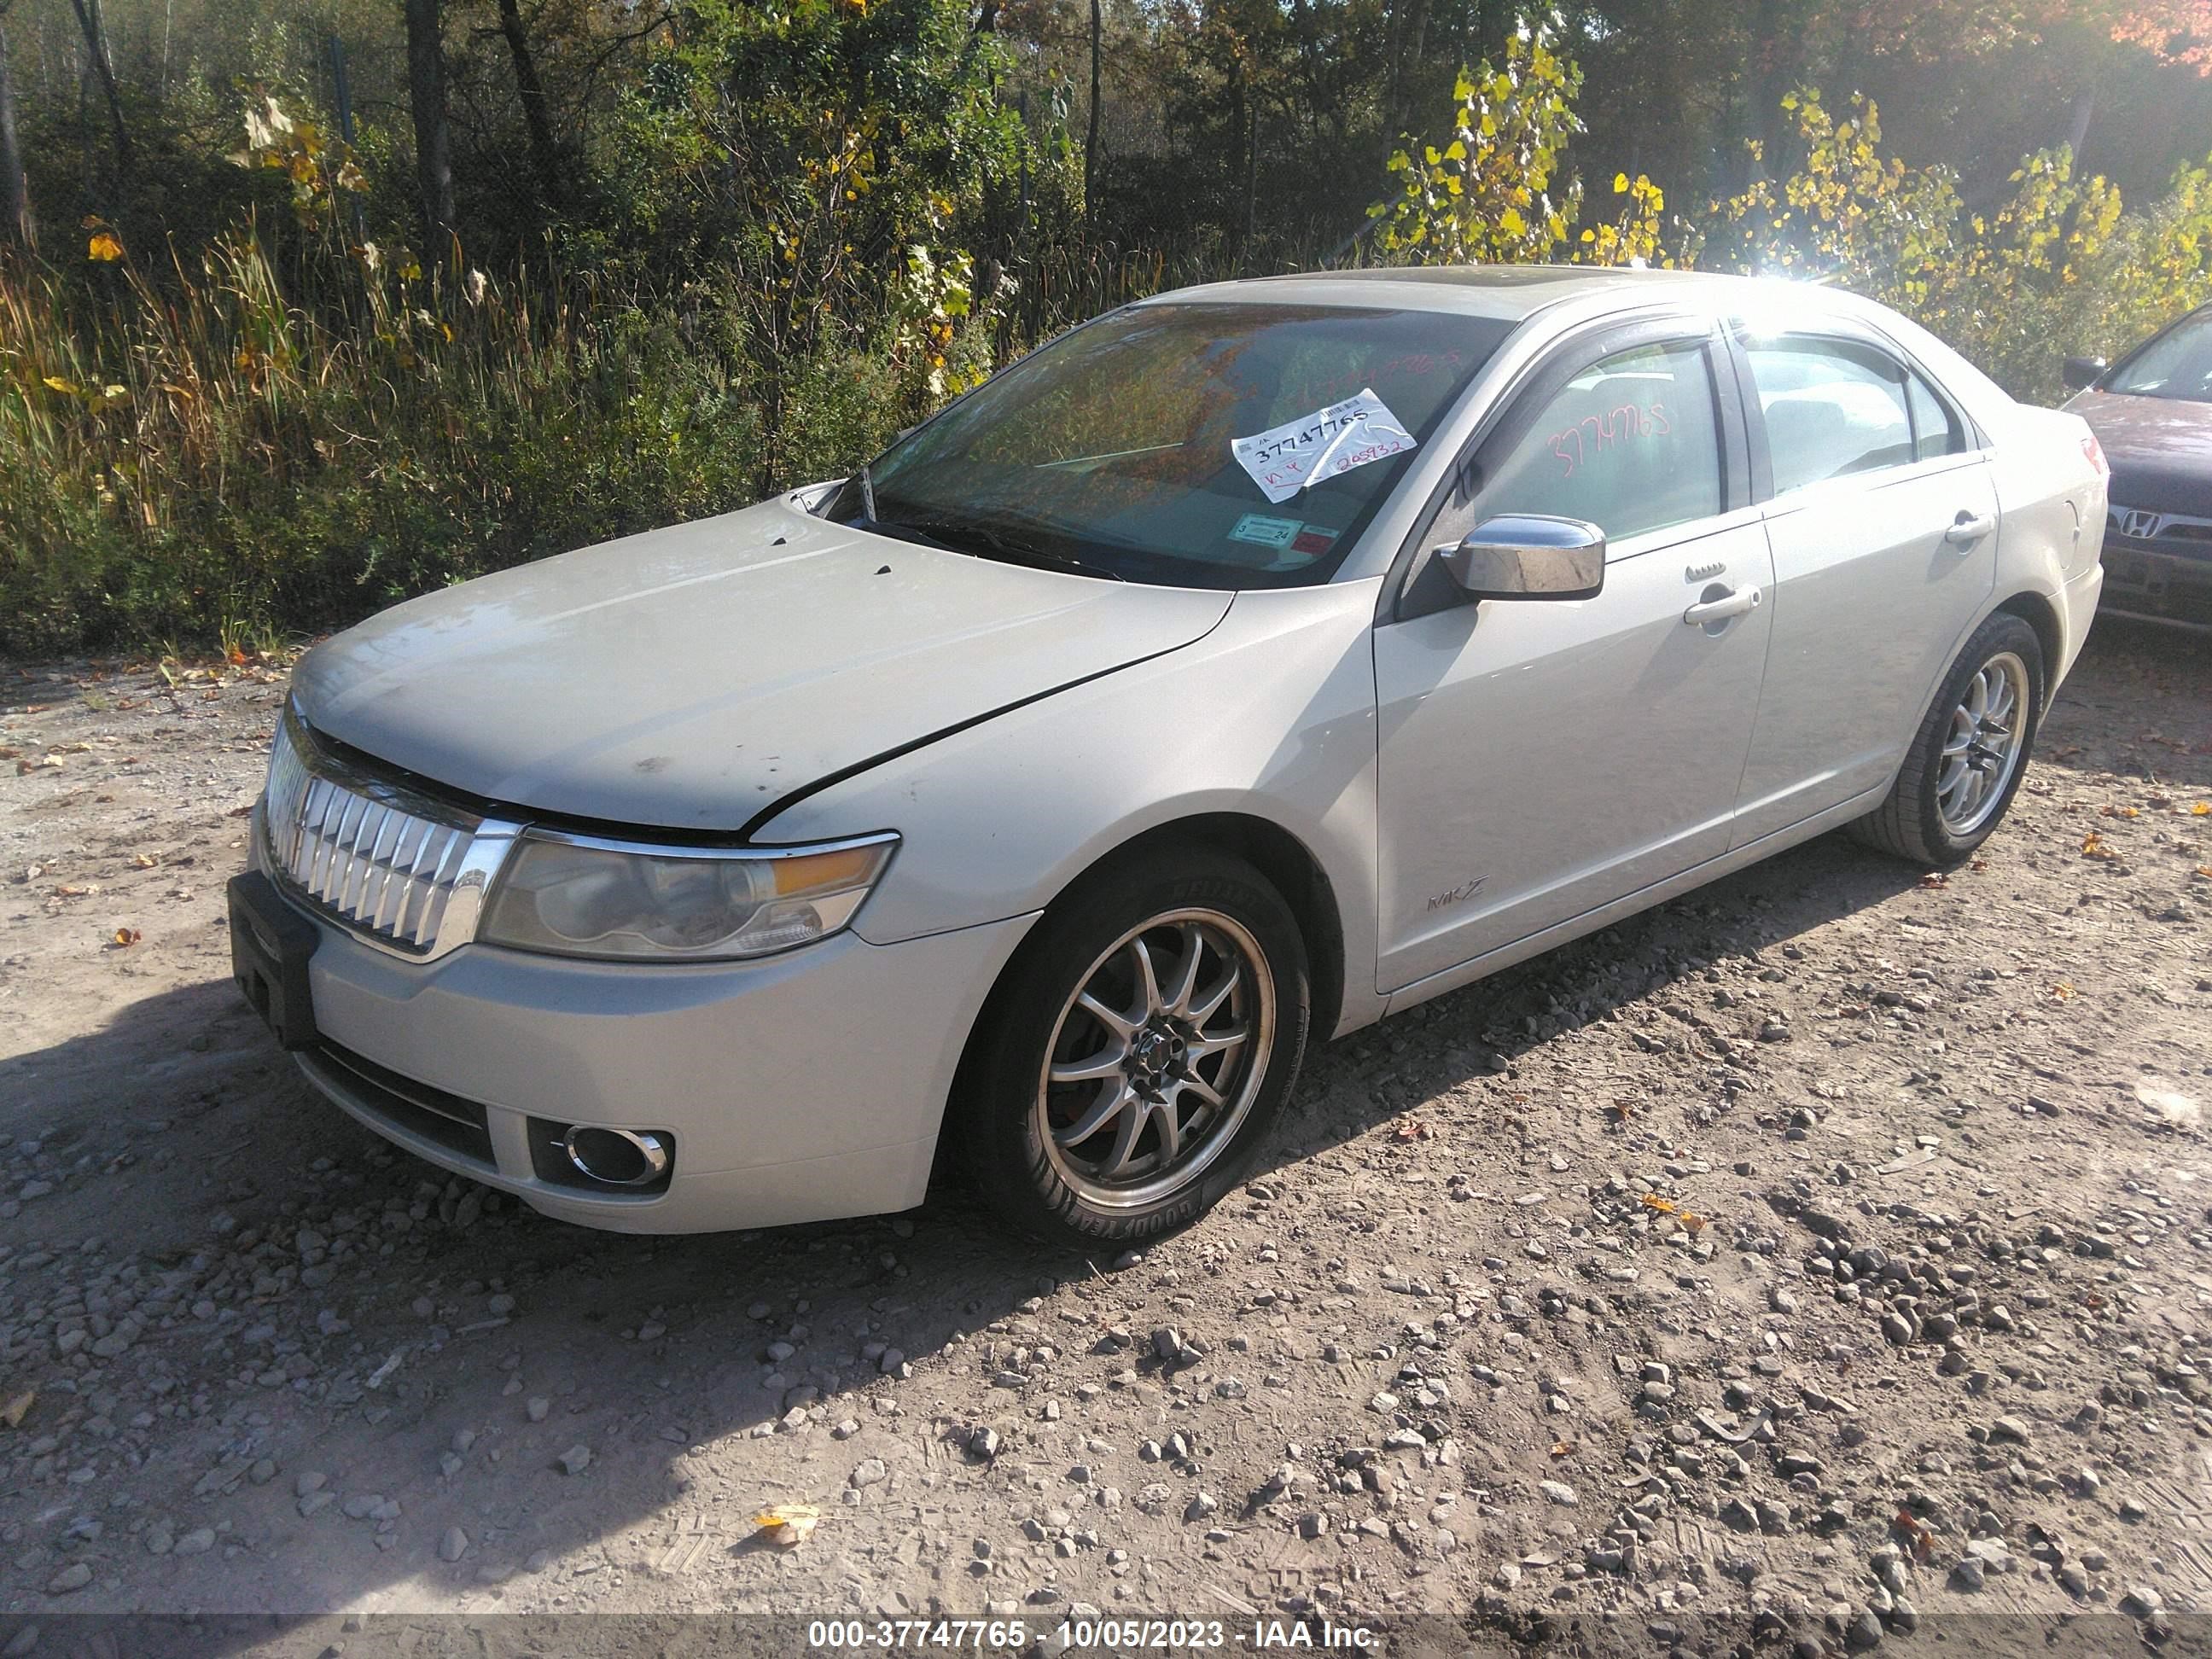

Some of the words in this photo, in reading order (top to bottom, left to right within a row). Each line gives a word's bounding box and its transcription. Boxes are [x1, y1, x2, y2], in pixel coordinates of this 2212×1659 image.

[1255, 409, 1368, 463] 37747765
[1547, 403, 1670, 479] 37747765
[1337, 441, 1404, 470] 205932
[1274, 531, 1289, 539] 24
[1427, 874, 1489, 912] MKZ
